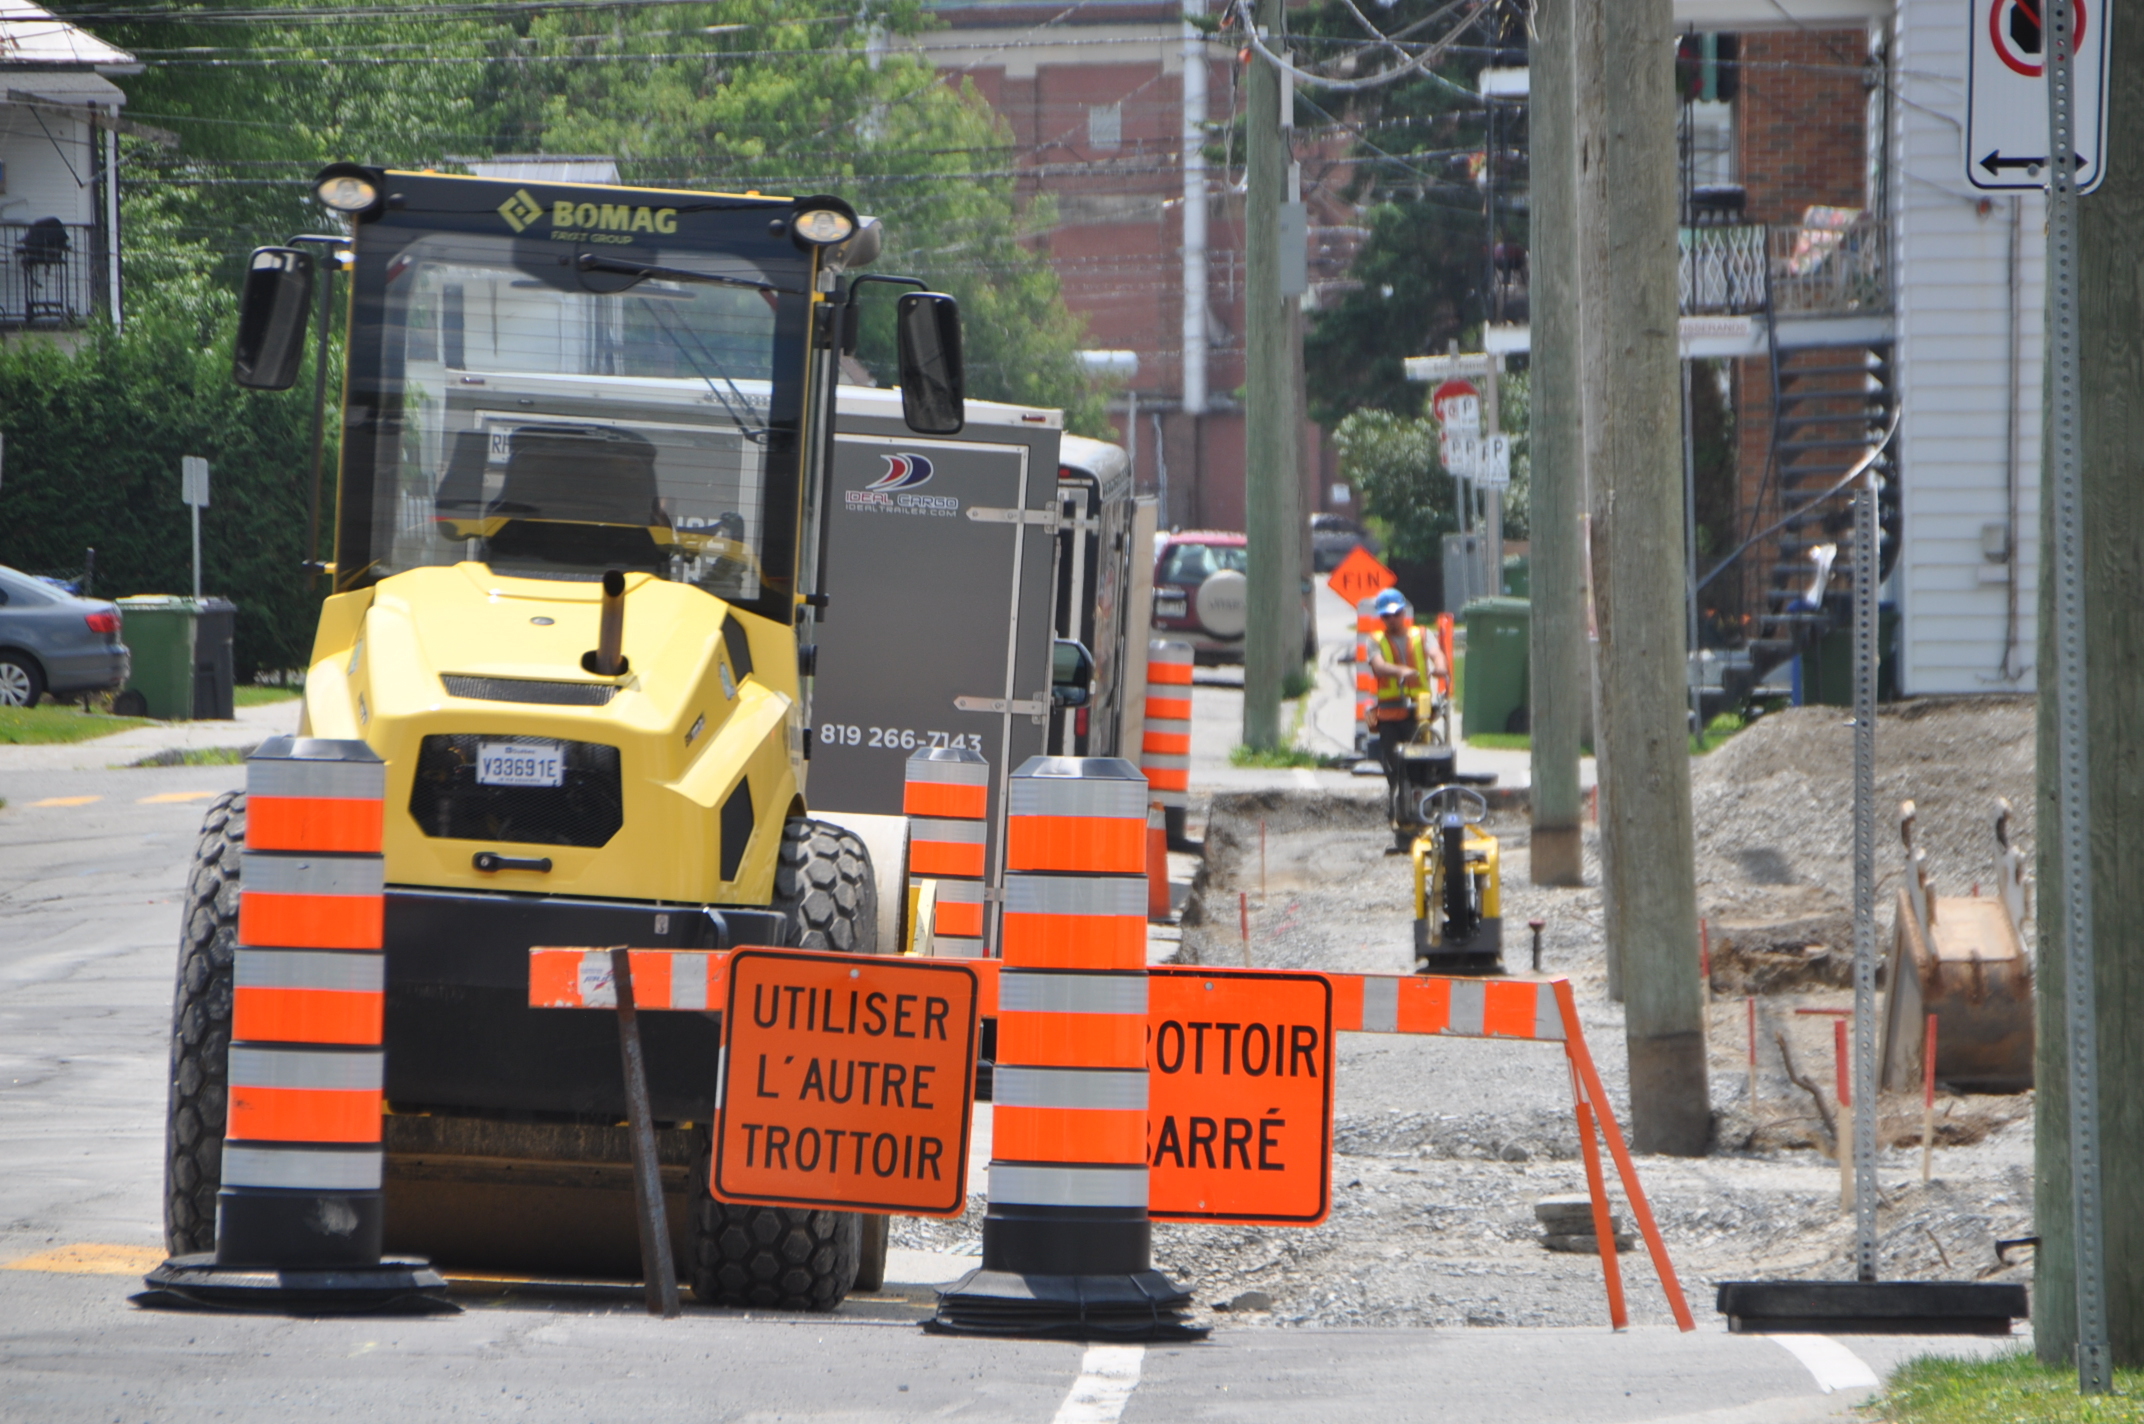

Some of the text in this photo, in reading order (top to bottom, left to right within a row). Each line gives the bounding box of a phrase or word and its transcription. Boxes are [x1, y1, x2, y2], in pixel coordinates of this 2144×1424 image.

[552, 201, 677, 234] BOMAG
[590, 233, 634, 245] GROUP
[845, 490, 959, 510] IDEAL CARGO
[845, 503, 957, 517] IDEALTRAILER.COM
[1342, 571, 1380, 591] FIN
[820, 723, 982, 752] 819 266-7143
[483, 757, 557, 778] V33691E
[753, 983, 950, 1041] UTILISER
[1147, 1020, 1318, 1078] OTTOIR
[741, 1123, 943, 1181] TROTTOIR
[1147, 1108, 1285, 1171] ARRÉ
